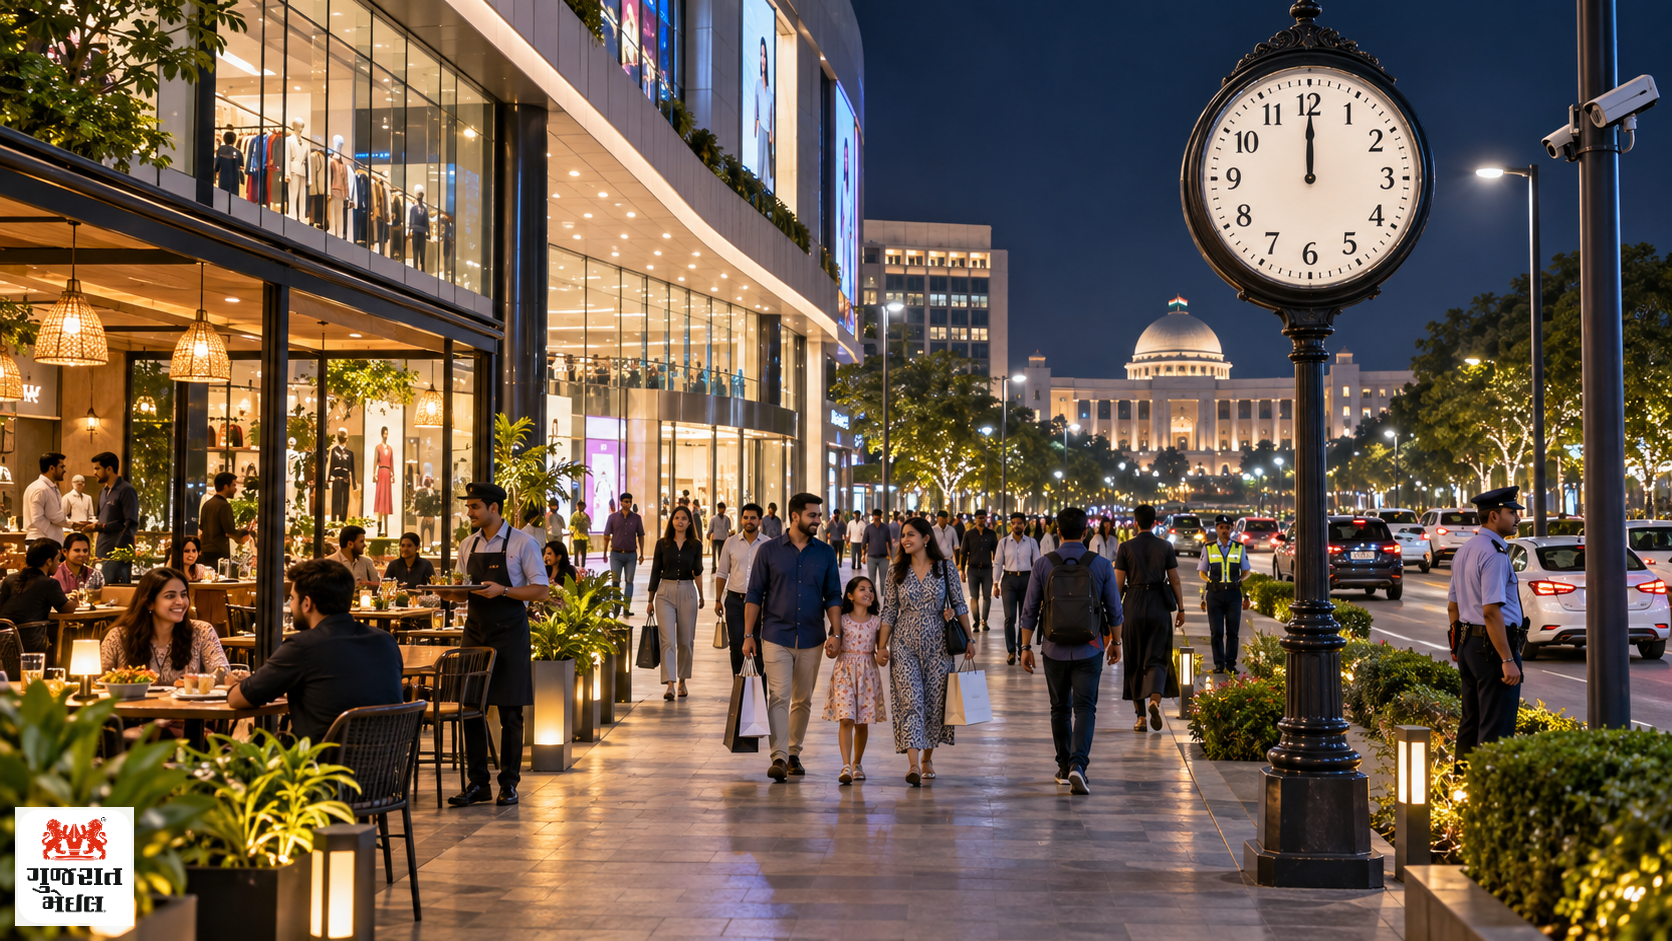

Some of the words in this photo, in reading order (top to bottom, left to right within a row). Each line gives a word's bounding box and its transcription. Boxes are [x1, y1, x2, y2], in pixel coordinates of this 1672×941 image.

[1262, 103, 1282, 126] 11
[1297, 92, 1321, 116] 12
[1343, 102, 1353, 125] 1
[1234, 130, 1259, 153] 10
[1368, 129, 1384, 152] 2
[1226, 167, 1242, 190] 9
[1380, 167, 1395, 190] 3
[1236, 204, 1252, 227] 8
[1368, 204, 1385, 227] 4
[1264, 231, 1280, 255] 7
[1302, 242, 1318, 265] 6
[1342, 231, 1357, 255] 5
